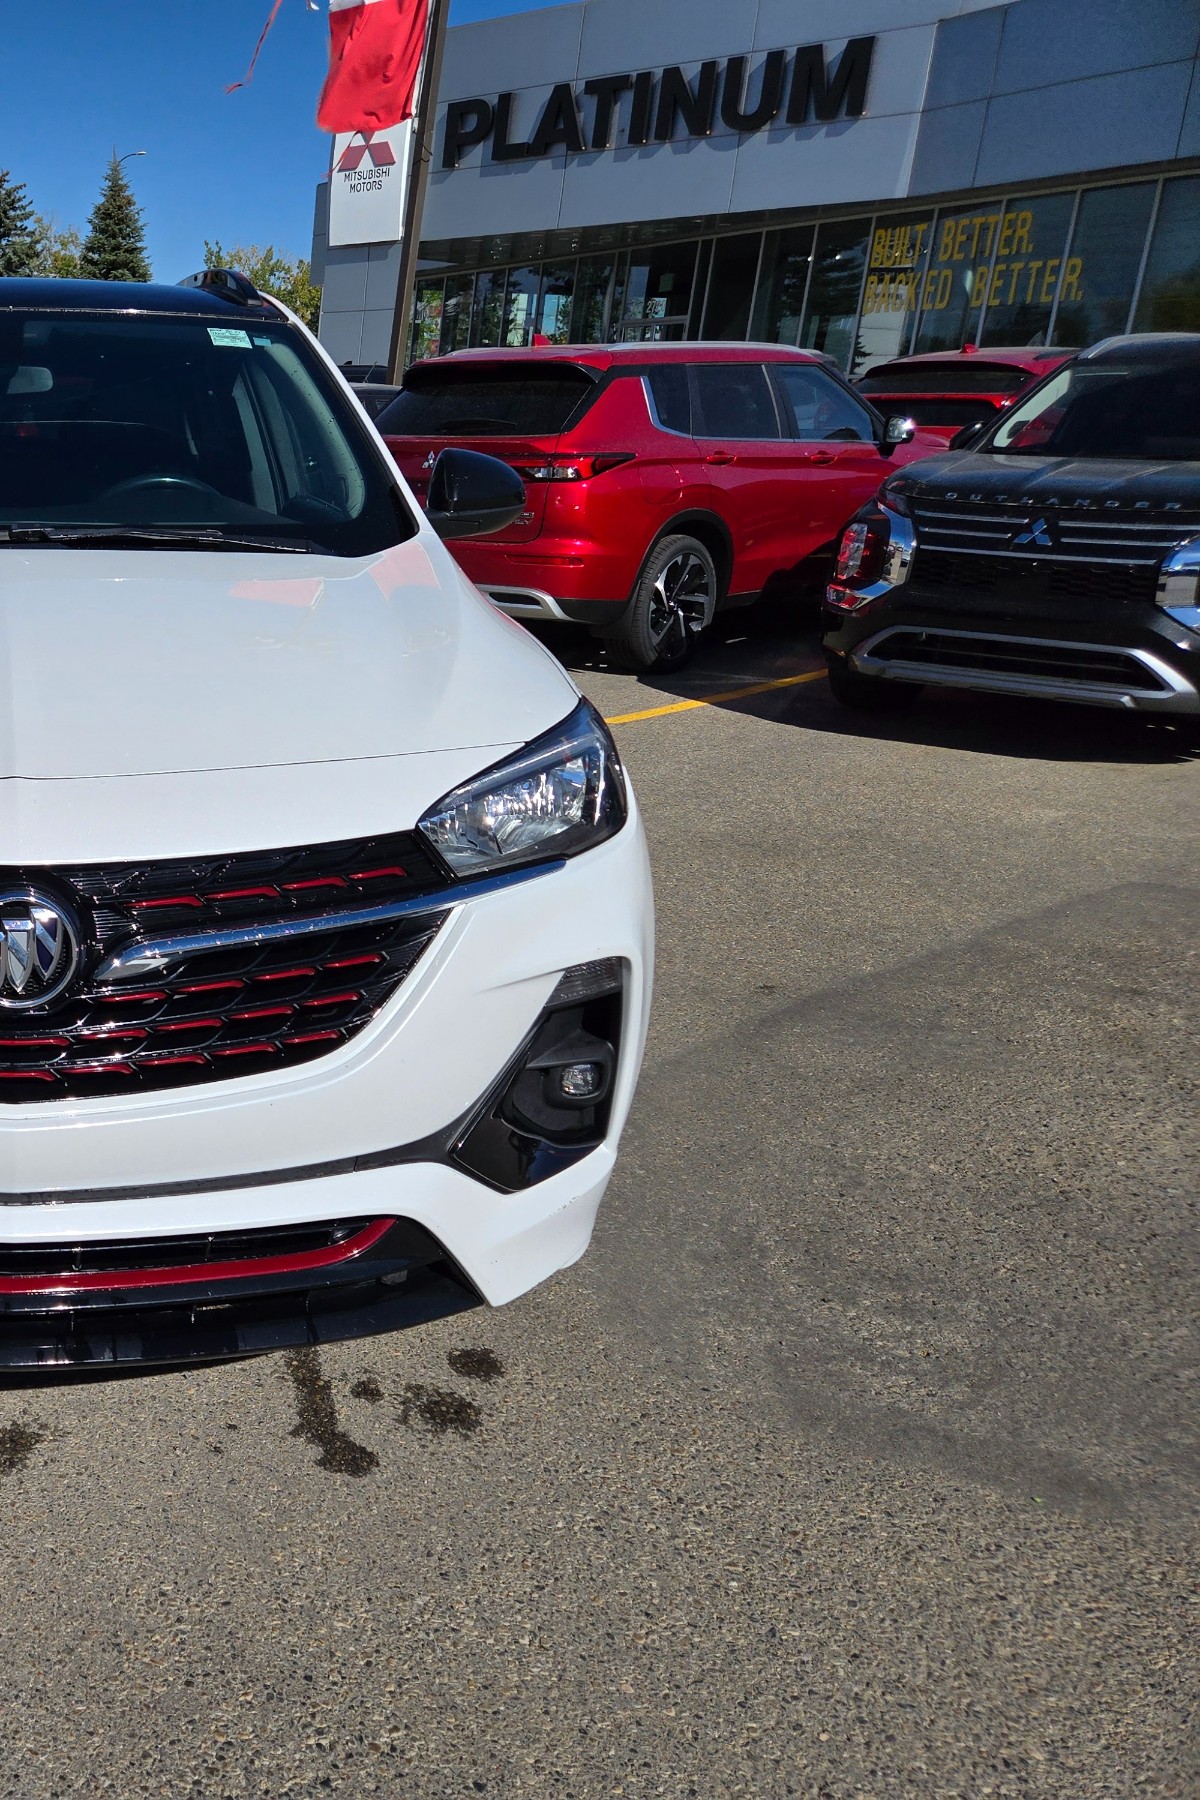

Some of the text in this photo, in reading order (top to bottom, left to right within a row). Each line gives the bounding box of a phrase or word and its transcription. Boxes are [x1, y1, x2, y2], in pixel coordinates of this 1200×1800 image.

[442, 35, 874, 168] PLATINUM
[344, 167, 390, 182] MITSUBISHI
[350, 180, 382, 193] MOTORS
[870, 224, 928, 268] BUILT
[863, 270, 952, 314] BACKED
[945, 492, 1181, 510] OUTLANDER
